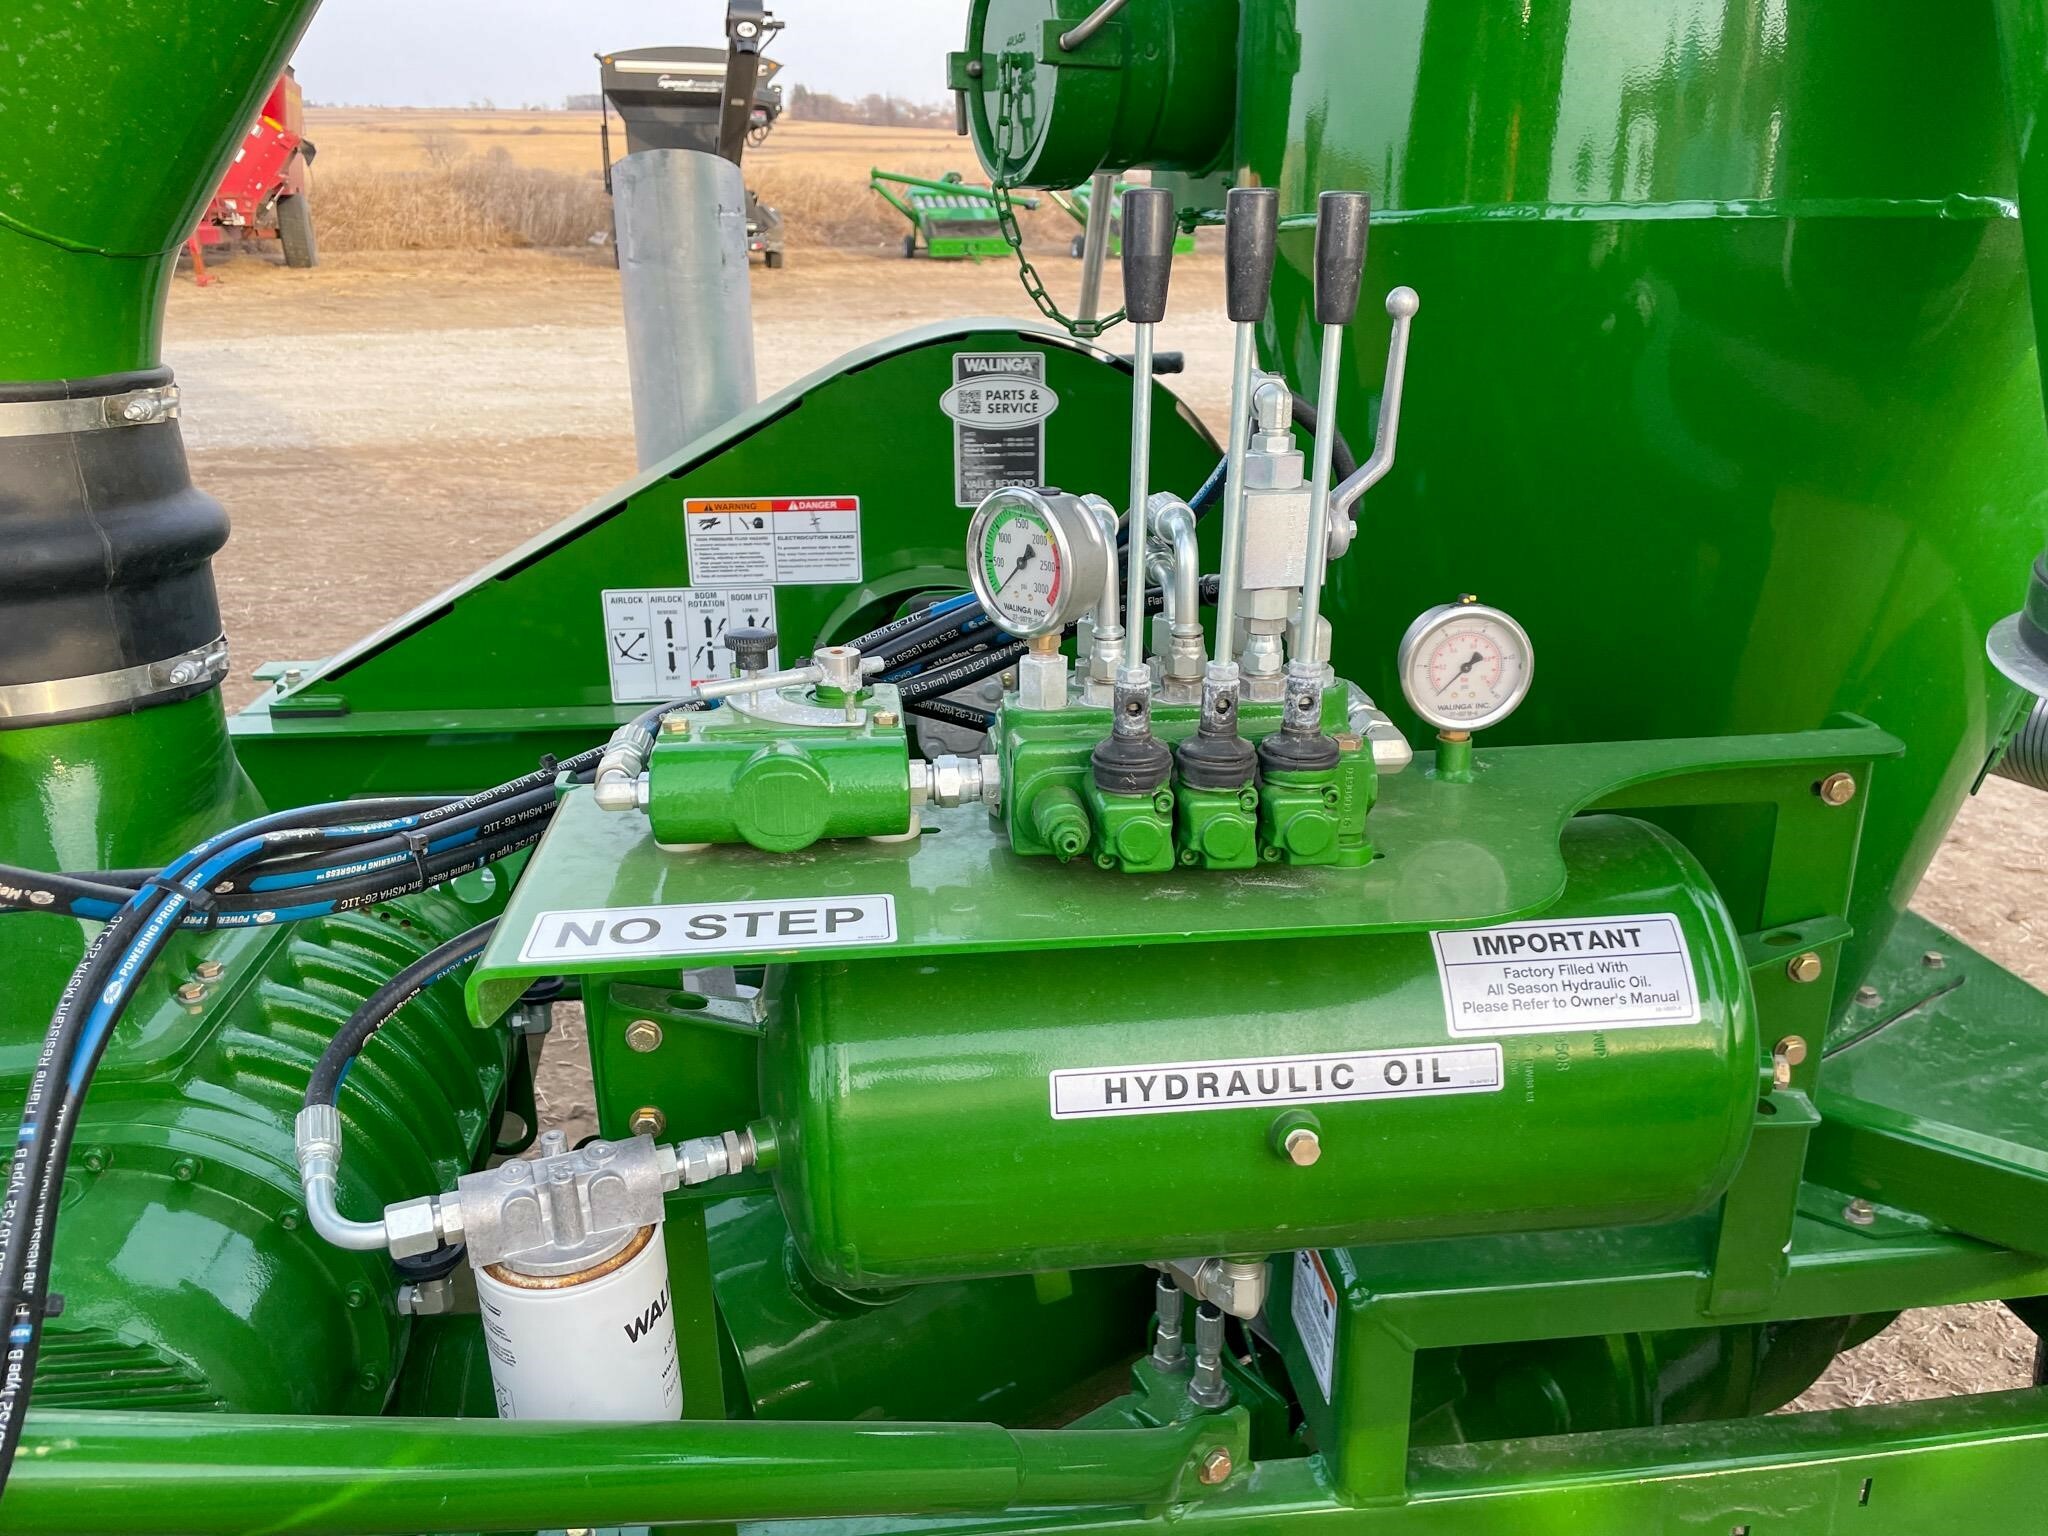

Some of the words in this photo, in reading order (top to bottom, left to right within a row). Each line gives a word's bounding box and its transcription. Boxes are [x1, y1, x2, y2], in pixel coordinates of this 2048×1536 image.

[964, 358, 1033, 372] WALINGA
[986, 390, 1025, 400] PARTS
[1030, 390, 1039, 400] &
[987, 403, 1038, 414] SERVICE
[964, 480, 994, 489] VALUE
[995, 479, 1036, 488] BEYOND
[714, 502, 757, 511] WARNING
[799, 501, 837, 510] DANGER
[1015, 518, 1029, 530] 1500
[998, 532, 1012, 544] 1000
[1032, 533, 1048, 546] 2000
[993, 557, 1005, 568] 500
[1040, 560, 1056, 572] 2500
[1033, 582, 1049, 594] 3000
[650, 595, 682, 603] AIRLOCK
[730, 593, 752, 601] BOOM
[688, 600, 725, 608] ROTATION
[1003, 602, 1031, 614] WALINGA
[864, 627, 889, 642] MSHA
[921, 638, 941, 649] MPa
[949, 668, 964, 681] ISO
[964, 656, 991, 675] 11237
[991, 648, 1007, 662] R17
[933, 703, 954, 716] MSHA
[1437, 703, 1473, 711] WALINGA
[444, 801, 466, 814] MPa
[577, 751, 593, 764] ISO
[518, 806, 544, 822] MSHA
[483, 817, 517, 835] 2G-11C
[367, 853, 407, 870] POWERING
[449, 860, 476, 878] Flame
[379, 886, 407, 900] MSHA
[341, 892, 378, 910] 2G-11C
[554, 916, 662, 949] NO
[684, 906, 865, 941] STEP
[86, 915, 123, 959] 2G-11C
[1472, 927, 1641, 957] IMPORTANT
[119, 923, 159, 977] POWERING
[1503, 966, 1555, 981] Factory
[1558, 963, 1594, 977] Filled
[1598, 961, 1628, 974] With
[66, 961, 91, 998] MSHA
[1487, 983, 1504, 996] All
[1507, 982, 1558, 995] Season
[1562, 979, 1626, 994] Hydraulic
[1629, 976, 1652, 988] Oil.
[1463, 1000, 1509, 1014] Please
[1513, 996, 1550, 1010] Refer
[1552, 997, 1567, 1009] to
[1570, 993, 1627, 1008] Owner's
[1631, 990, 1680, 1004] Manual
[39, 1000, 71, 1067] Resistant
[1104, 1062, 1355, 1105] HYDRAULIC
[1383, 1057, 1452, 1087] OIL
[25, 1069, 47, 1114] Flame
[15, 1147, 28, 1158] B
[7, 1160, 26, 1195] Type
[8, 1348, 24, 1360] B
[1, 1364, 22, 1397] Type
